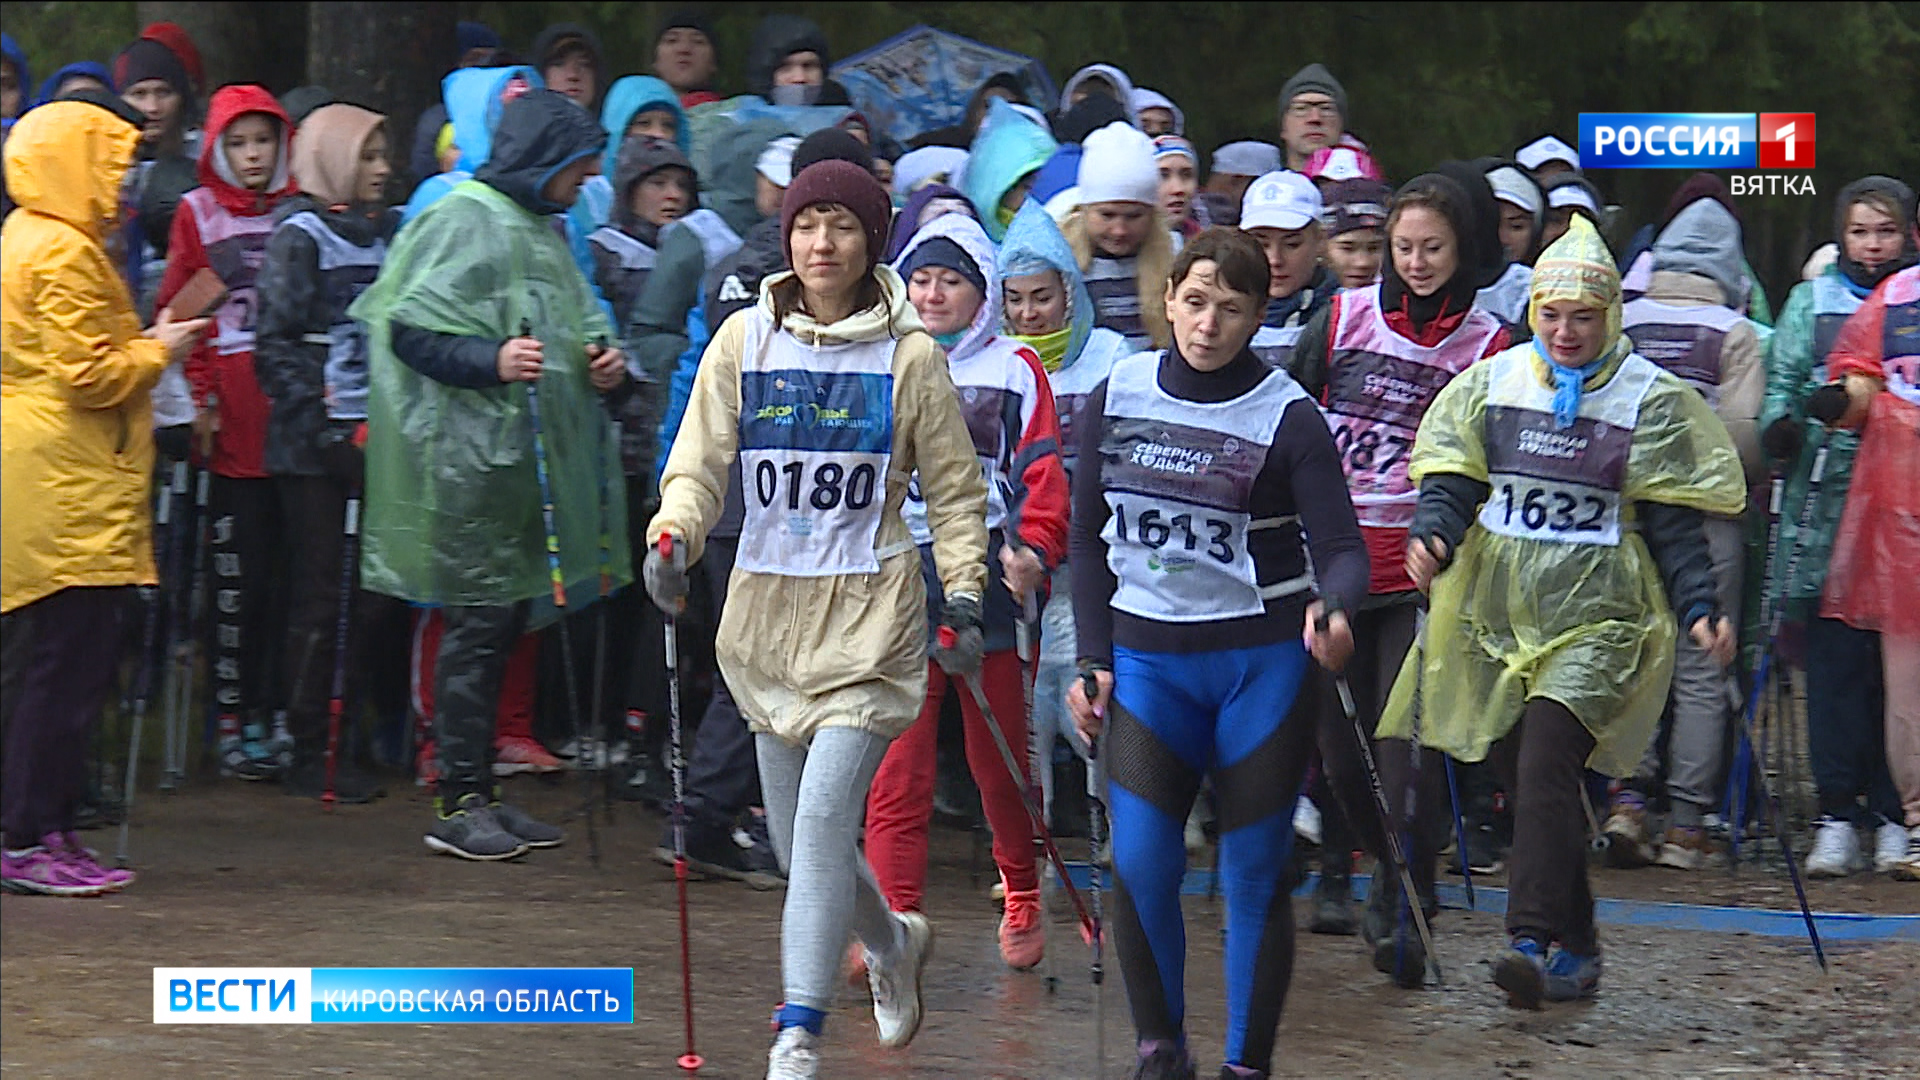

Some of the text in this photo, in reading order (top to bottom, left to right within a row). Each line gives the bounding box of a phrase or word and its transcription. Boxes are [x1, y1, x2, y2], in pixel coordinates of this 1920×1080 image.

[1135, 442, 1214, 466] СЕВЕРНАЯ
[755, 459, 876, 511] 0180
[1502, 483, 1607, 532] 1632
[1115, 503, 1235, 564] 1613
